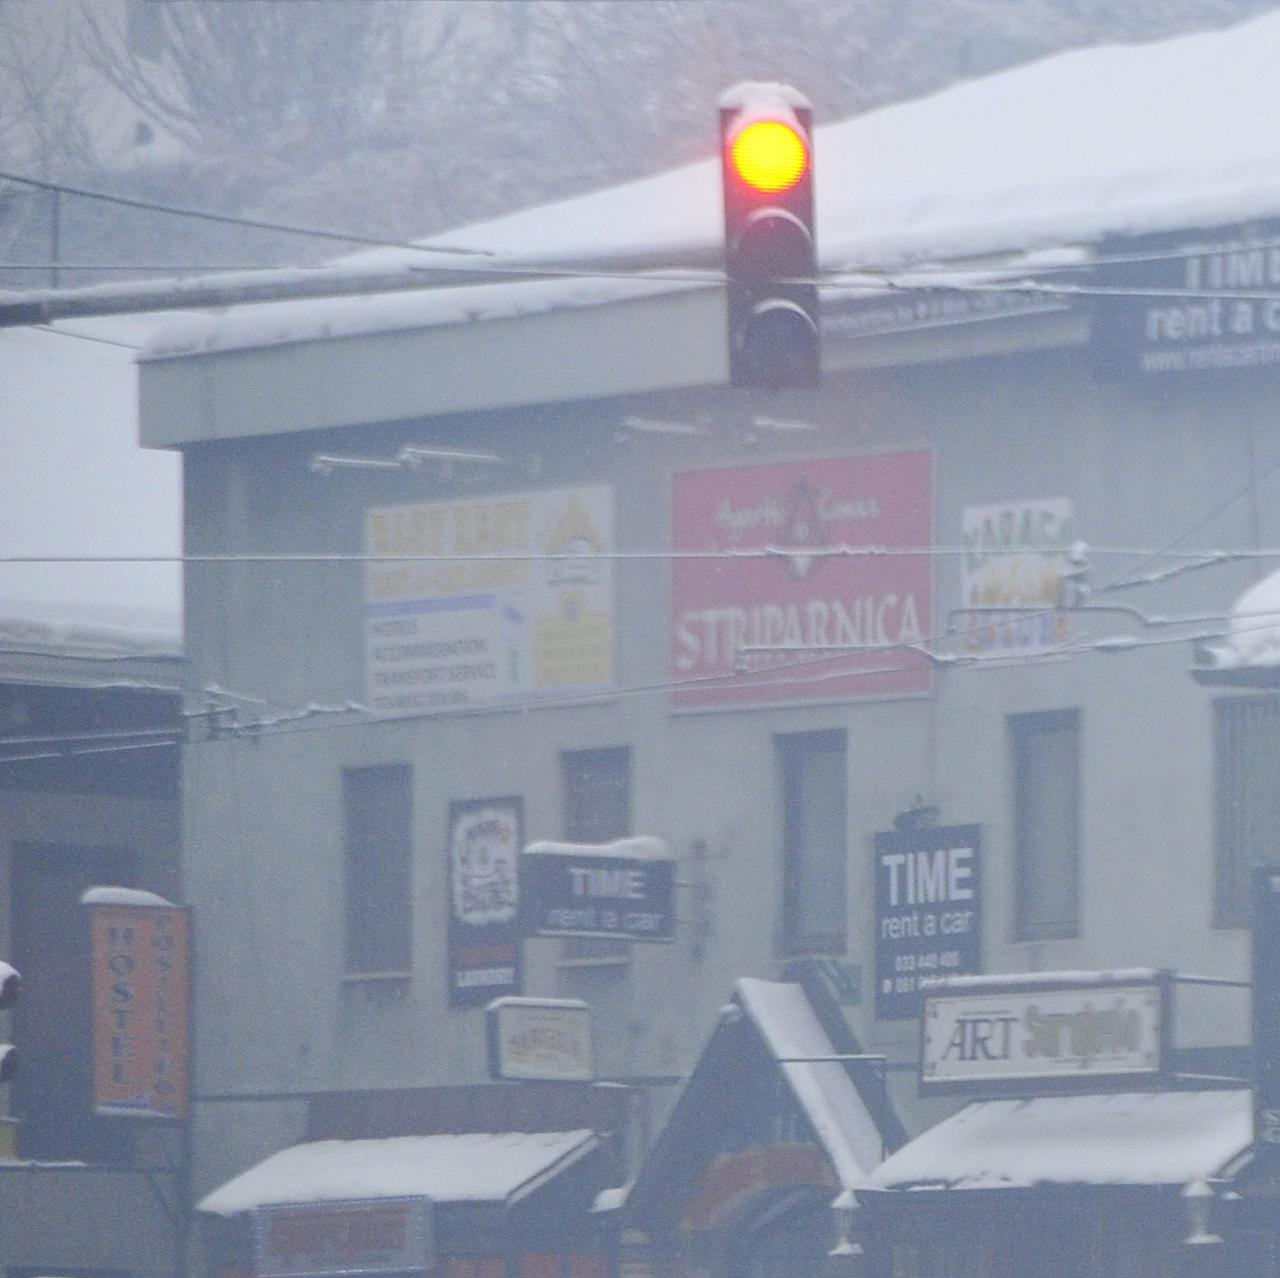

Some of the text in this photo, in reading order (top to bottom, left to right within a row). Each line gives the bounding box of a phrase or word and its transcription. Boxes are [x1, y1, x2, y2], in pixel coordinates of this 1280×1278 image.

[1145, 299, 1220, 341] rent
[1230, 301, 1253, 334] a
[568, 867, 647, 901] TIME
[882, 847, 974, 906] TIME
[545, 904, 664, 934] rent a car
[882, 910, 974, 941] rent a car
[107, 926, 137, 1086] HOSTEL
[940, 1016, 1020, 1063] ART
